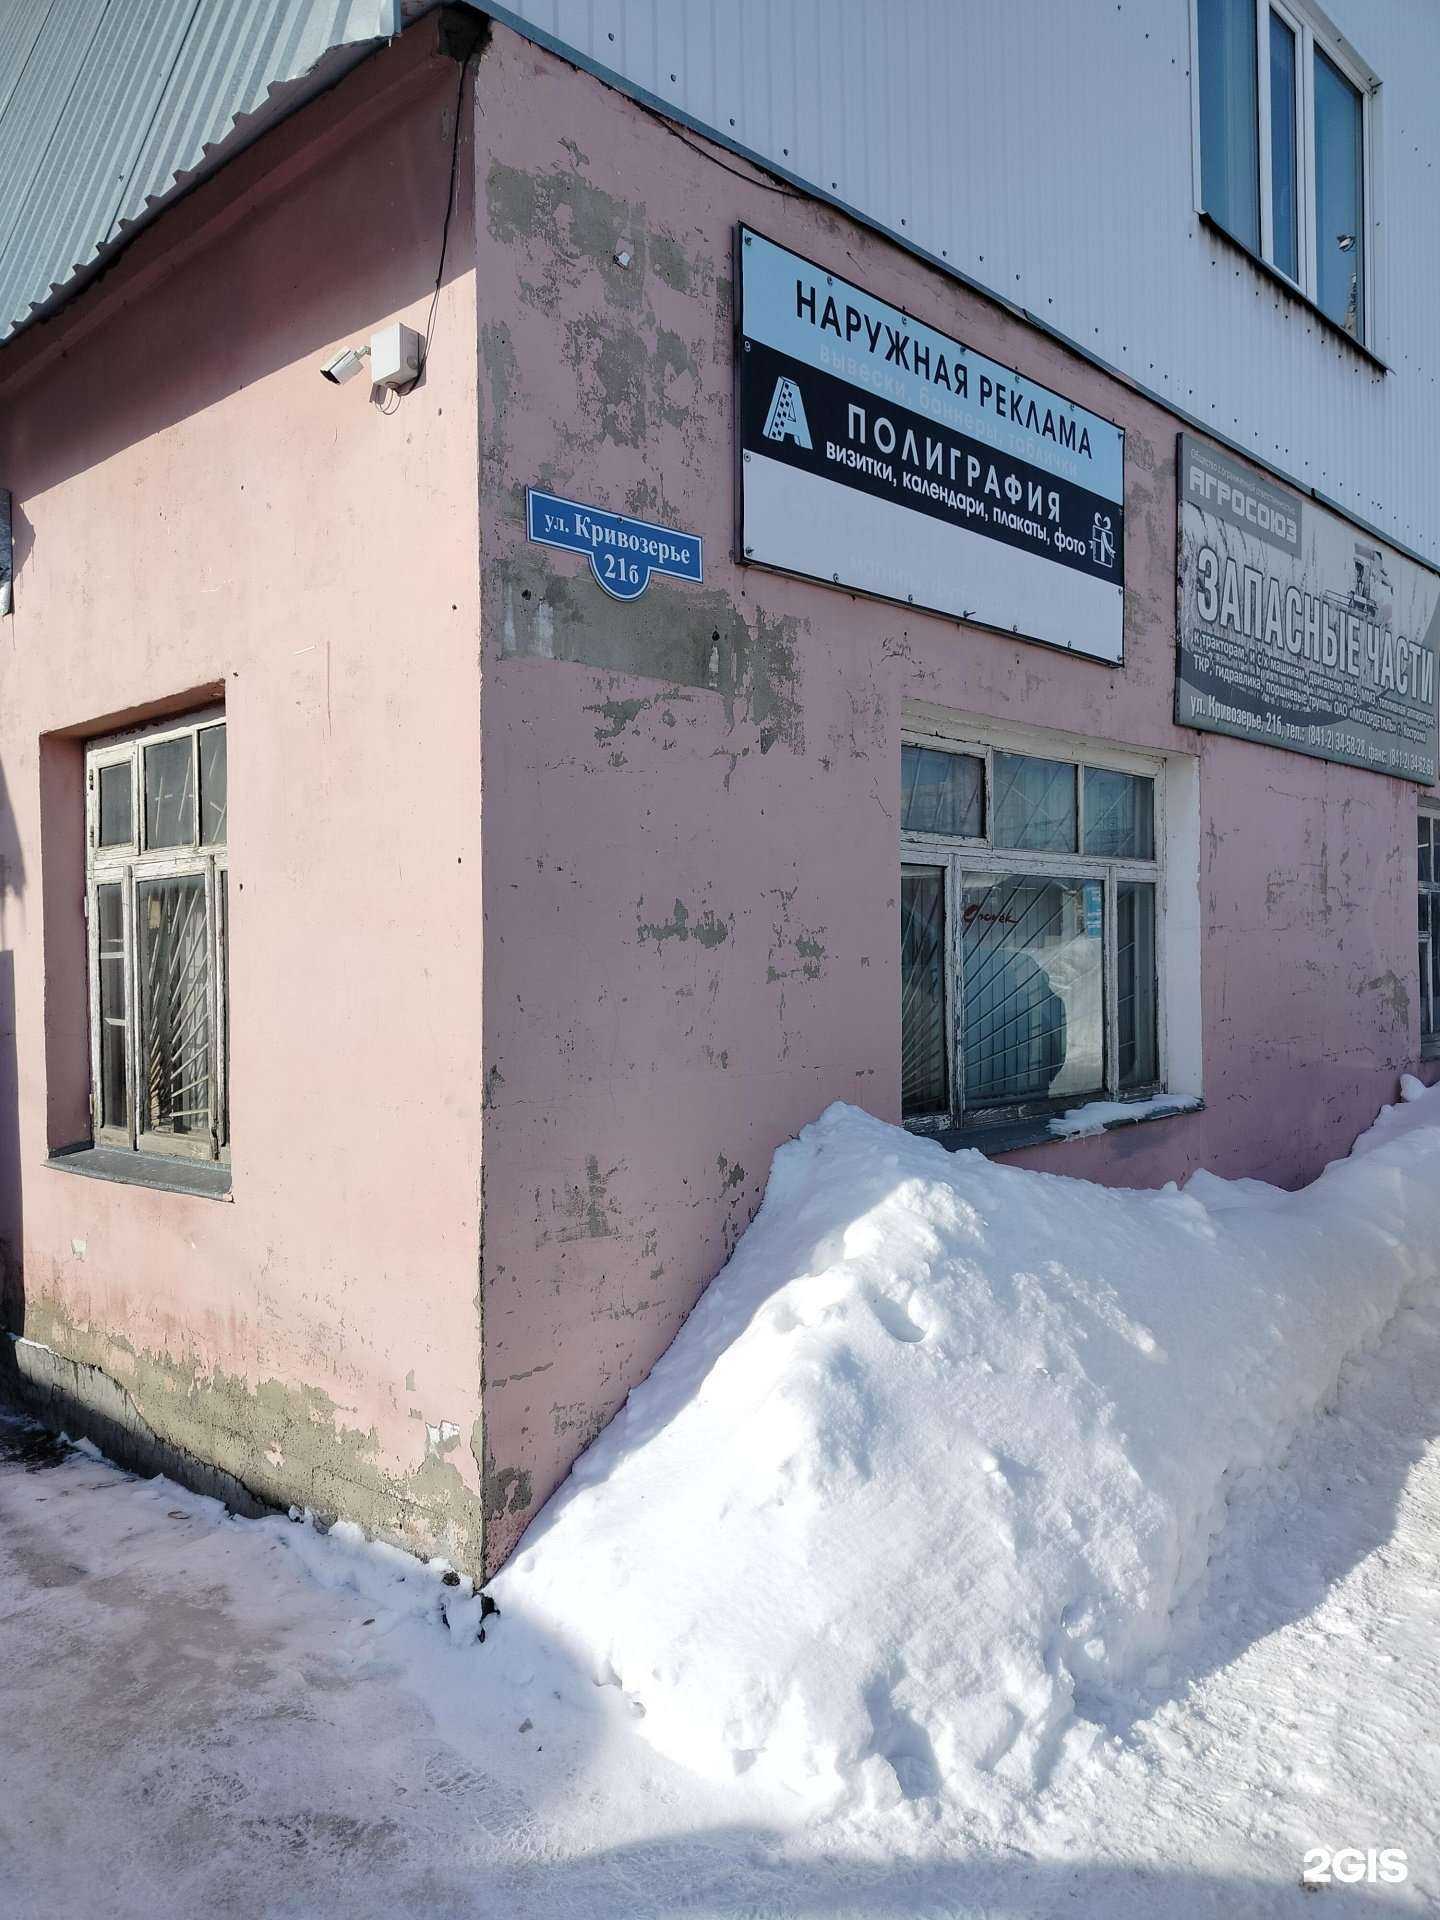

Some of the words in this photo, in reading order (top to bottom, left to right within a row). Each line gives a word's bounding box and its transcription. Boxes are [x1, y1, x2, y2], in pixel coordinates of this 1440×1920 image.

[796, 280, 968, 399] НАРУЖНАЯ
[979, 374, 1093, 460] РЕКЛАМА
[848, 403, 1060, 522] ПОЛИГРАФИЯ
[826, 441, 897, 487] визитки,
[903, 472, 988, 522] календари,
[993, 507, 1050, 545] плакаты,
[1054, 527, 1086, 555] фото
[1190, 465, 1297, 544] АГРОСОЮЗ
[544, 513, 569, 532] ул.
[574, 513, 691, 564] Кривозерье
[604, 553, 639, 584] 21б
[1197, 547, 1360, 677] ЗАПАСНЫЕ
[1367, 623, 1434, 704] ЧАСТИ
[1201, 633, 1248, 663] тракторам,
[1190, 695, 1206, 717] ул.
[1208, 694, 1265, 733] Кривозерье,
[1215, 664, 1264, 693] гидравлика,
[1333, 700, 1348, 717] ОАО
